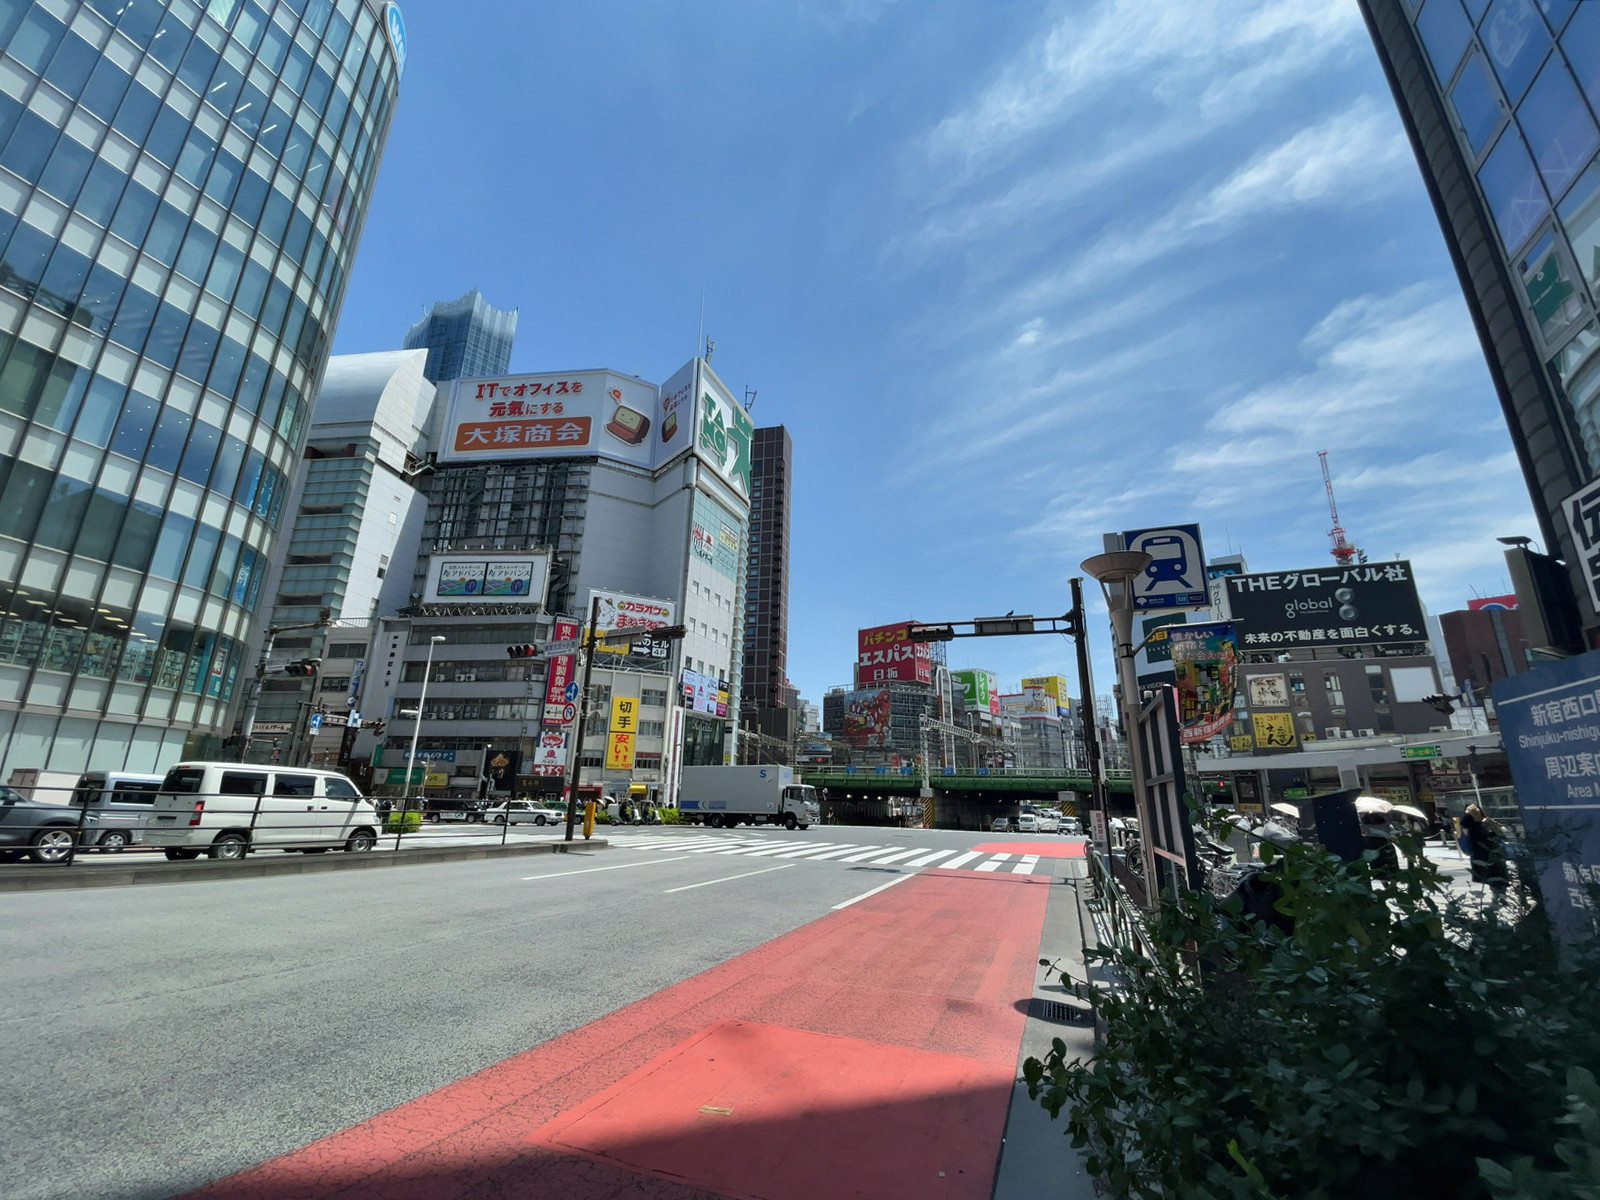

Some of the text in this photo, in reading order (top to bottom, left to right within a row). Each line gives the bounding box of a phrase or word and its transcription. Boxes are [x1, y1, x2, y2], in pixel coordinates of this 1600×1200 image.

[475, 381, 583, 400] ITでオフィスを
[489, 401, 564, 417] 元気にする
[463, 422, 583, 445] 大塚商会
[1231, 564, 1408, 593] THEグローバル社
[624, 602, 662, 615] カラオケ
[1285, 597, 1333, 619] global
[864, 629, 908, 646] パチンコ
[1245, 624, 1420, 644] 未来の不動産を面白くする。
[860, 644, 914, 666] エスパス
[617, 701, 632, 729] 切手
[1567, 783, 1593, 798] Area
